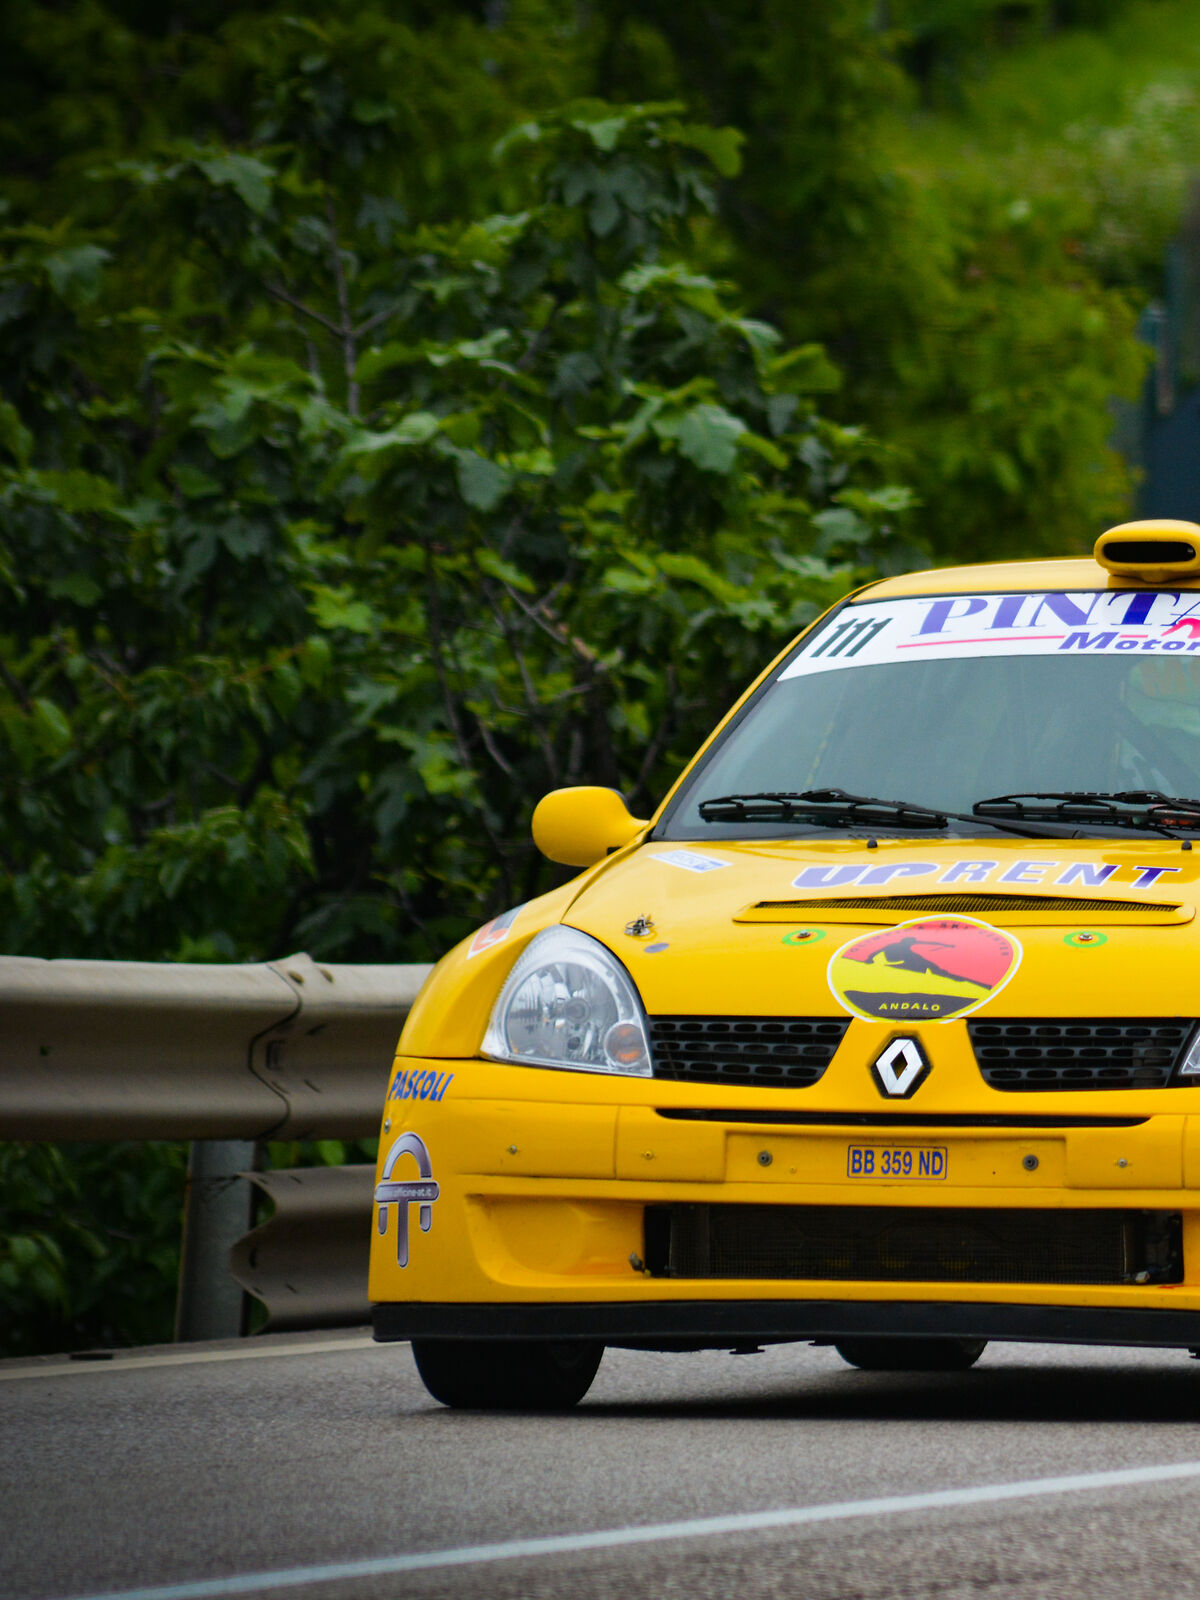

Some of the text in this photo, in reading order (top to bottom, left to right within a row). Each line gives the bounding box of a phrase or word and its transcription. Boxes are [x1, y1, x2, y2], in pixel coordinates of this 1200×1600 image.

[809, 617, 894, 658] 111
[878, 1001, 942, 1012] ANDALO
[387, 1069, 455, 1102] PASCOLI
[851, 1149, 944, 1176] BB 359 ND
